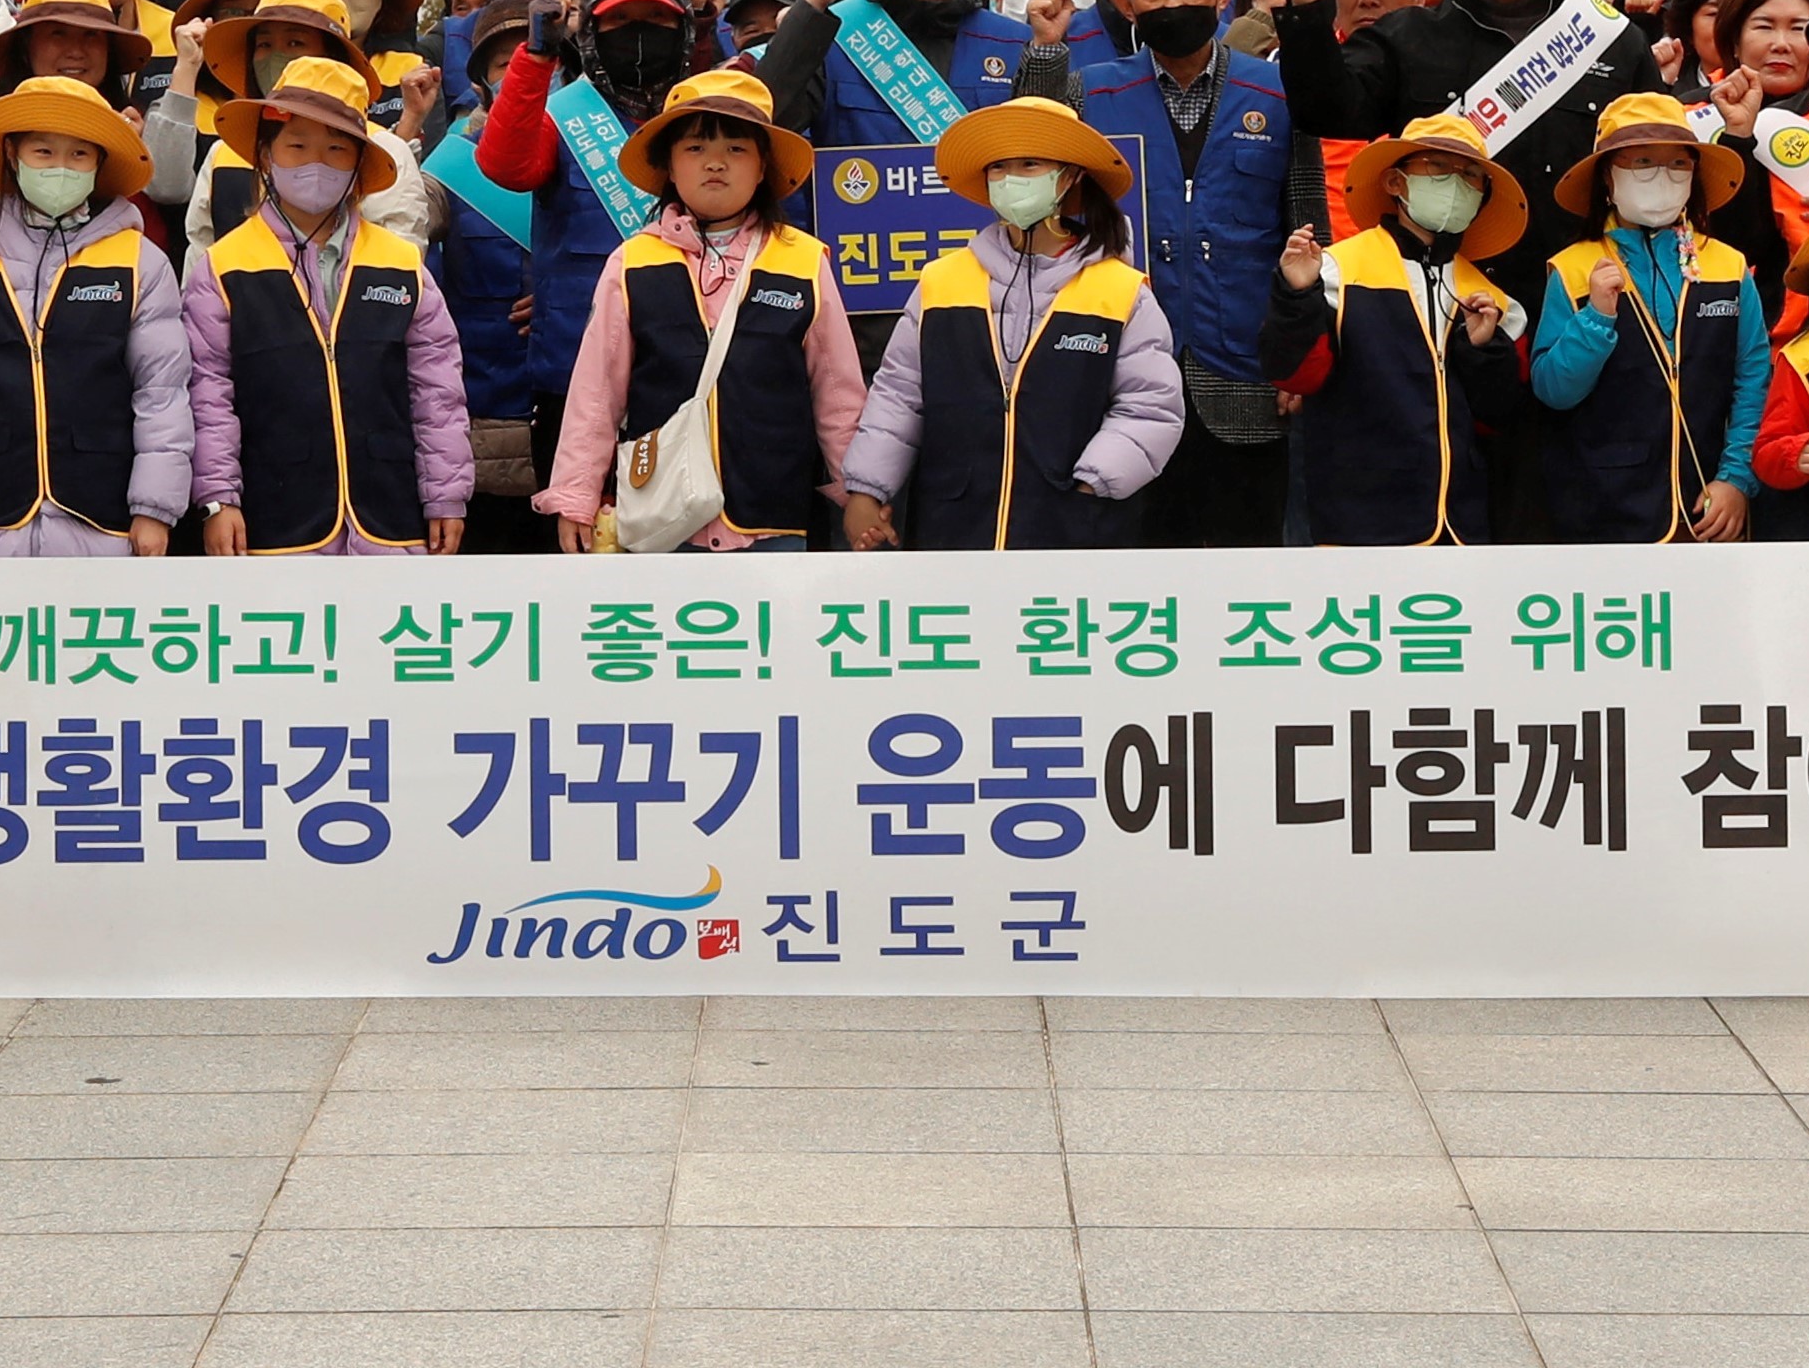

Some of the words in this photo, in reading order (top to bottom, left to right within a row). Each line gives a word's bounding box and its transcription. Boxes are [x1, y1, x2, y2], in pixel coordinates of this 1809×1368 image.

[846, 30, 895, 84] 진도를
[866, 18, 900, 51] 노인
[893, 48, 932, 88] 학대
[381, 602, 541, 683] 살기
[580, 600, 772, 682] 좋은!
[817, 599, 981, 678] 진도
[1017, 596, 1179, 677] 환경
[1220, 593, 1472, 676] 조성을
[1511, 591, 1672, 673] 위해
[448, 716, 800, 861] 가꾸기
[857, 711, 1214, 860] 운동에
[1274, 707, 1628, 853] 다함께
[426, 902, 688, 964] Jindo
[761, 890, 1086, 963] 진도군
